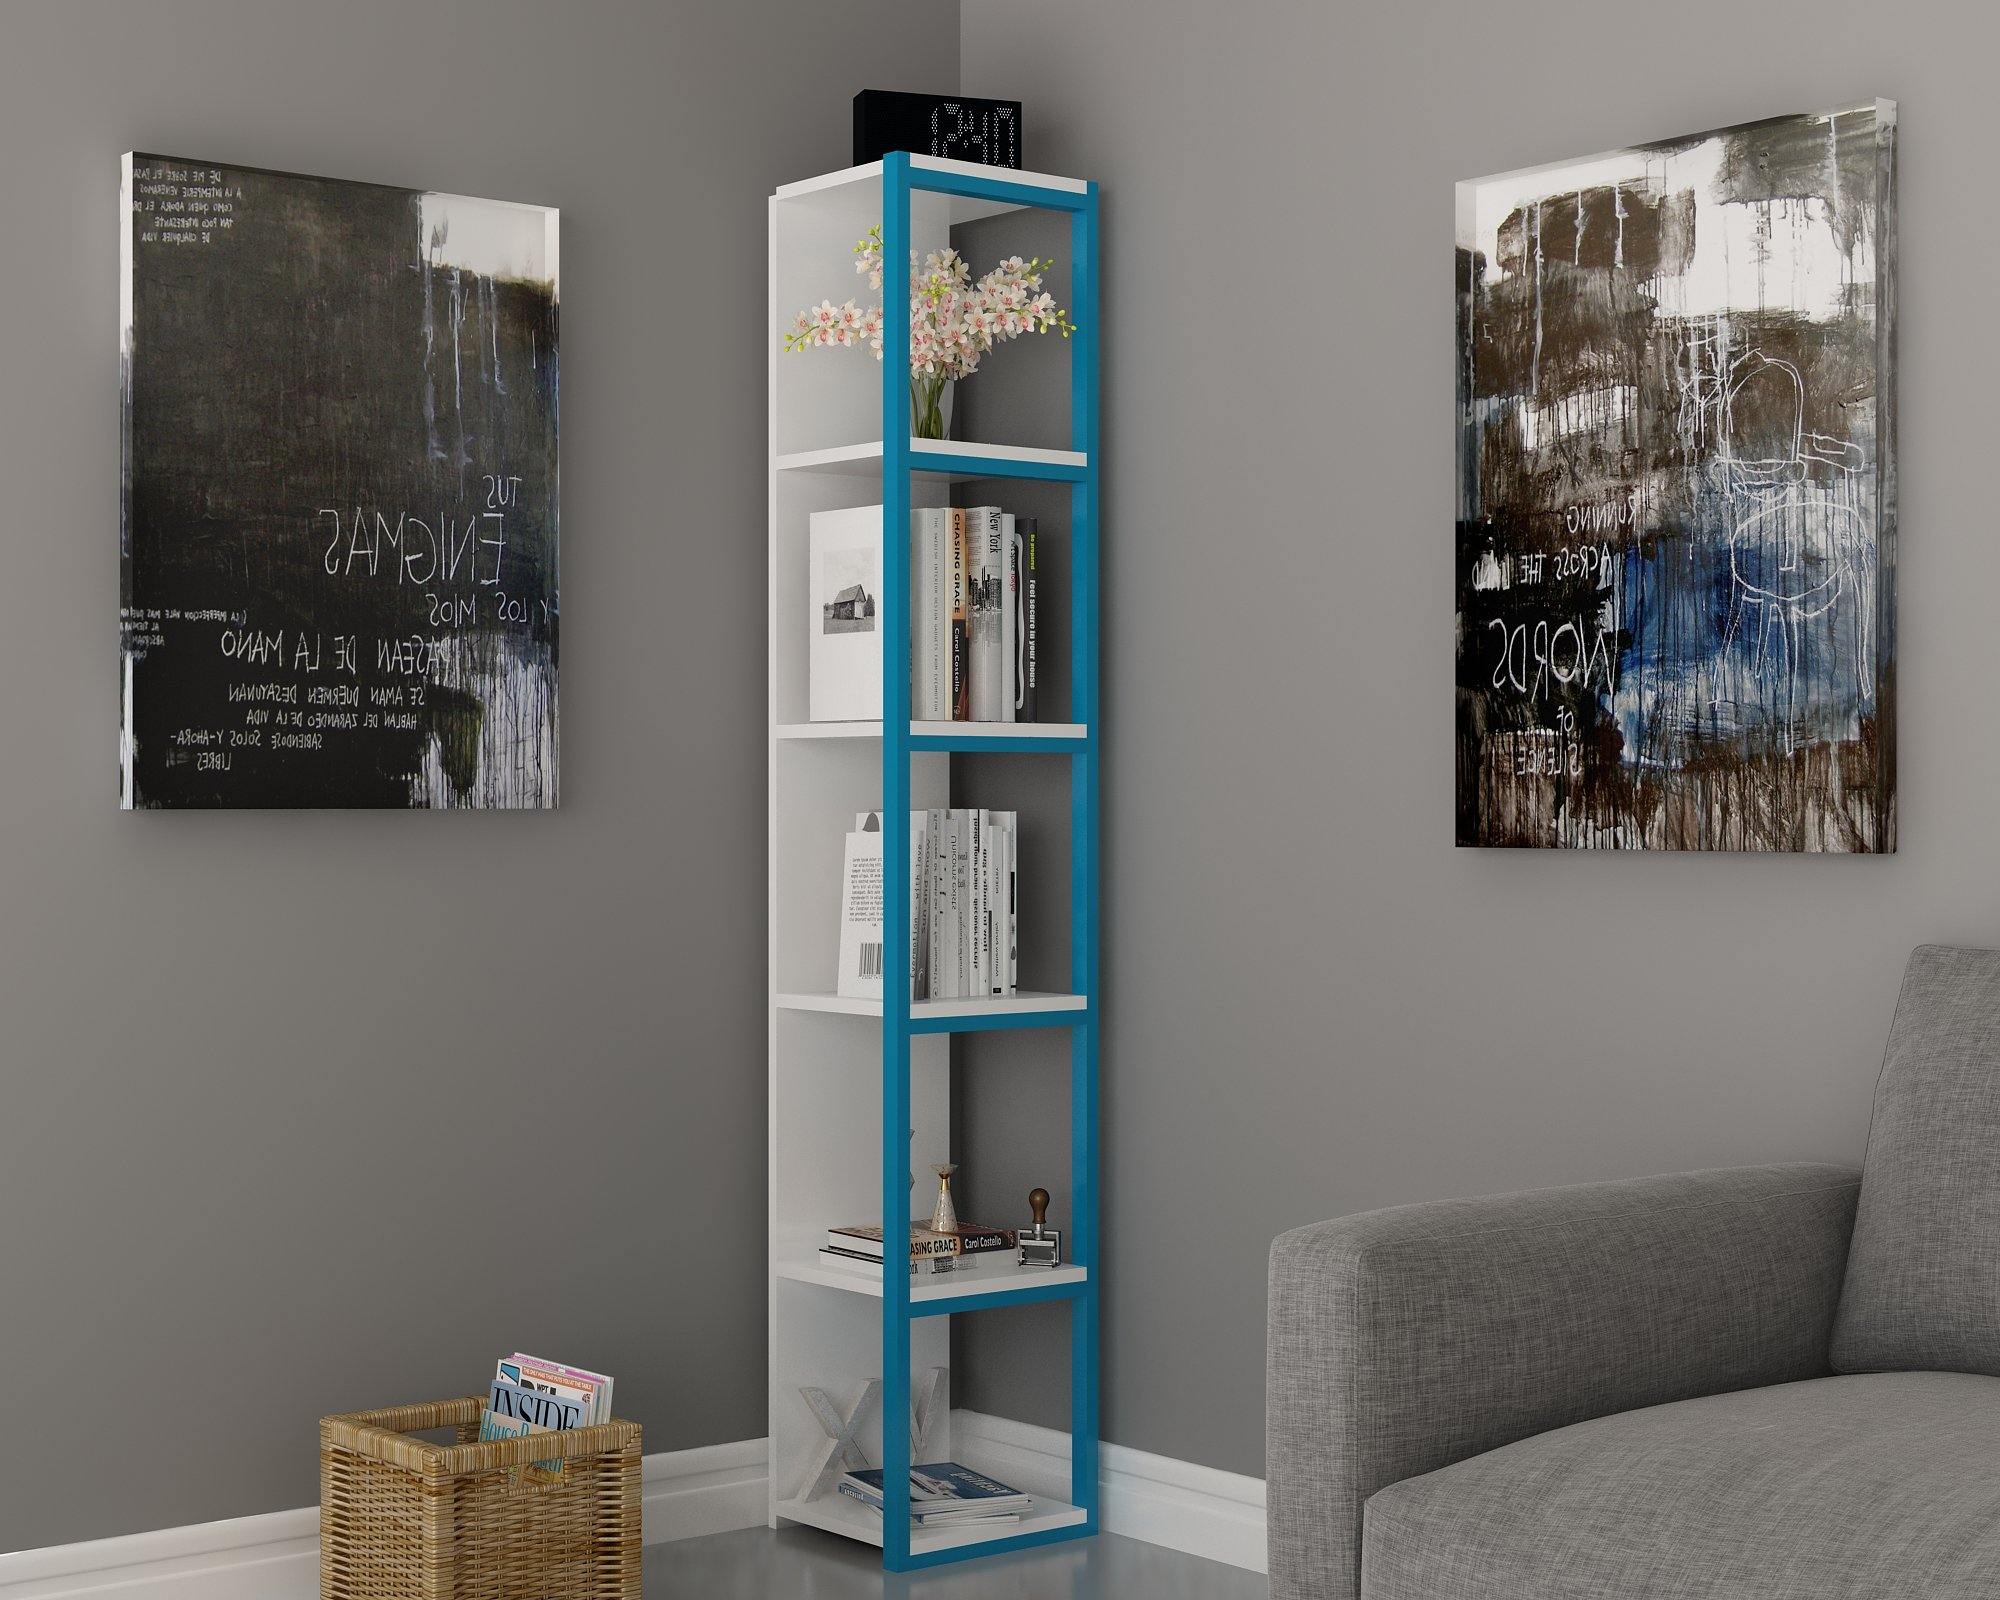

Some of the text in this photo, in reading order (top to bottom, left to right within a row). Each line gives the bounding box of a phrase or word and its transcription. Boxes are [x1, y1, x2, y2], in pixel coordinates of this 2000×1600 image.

[990, 512, 1002, 554] New York
[1030, 630, 1036, 639] in
[910, 1234, 1002, 1256] ASING GRACE Carol Costello
[536, 1383, 548, 1394] WPT
[494, 1386, 580, 1430] INSIDE
